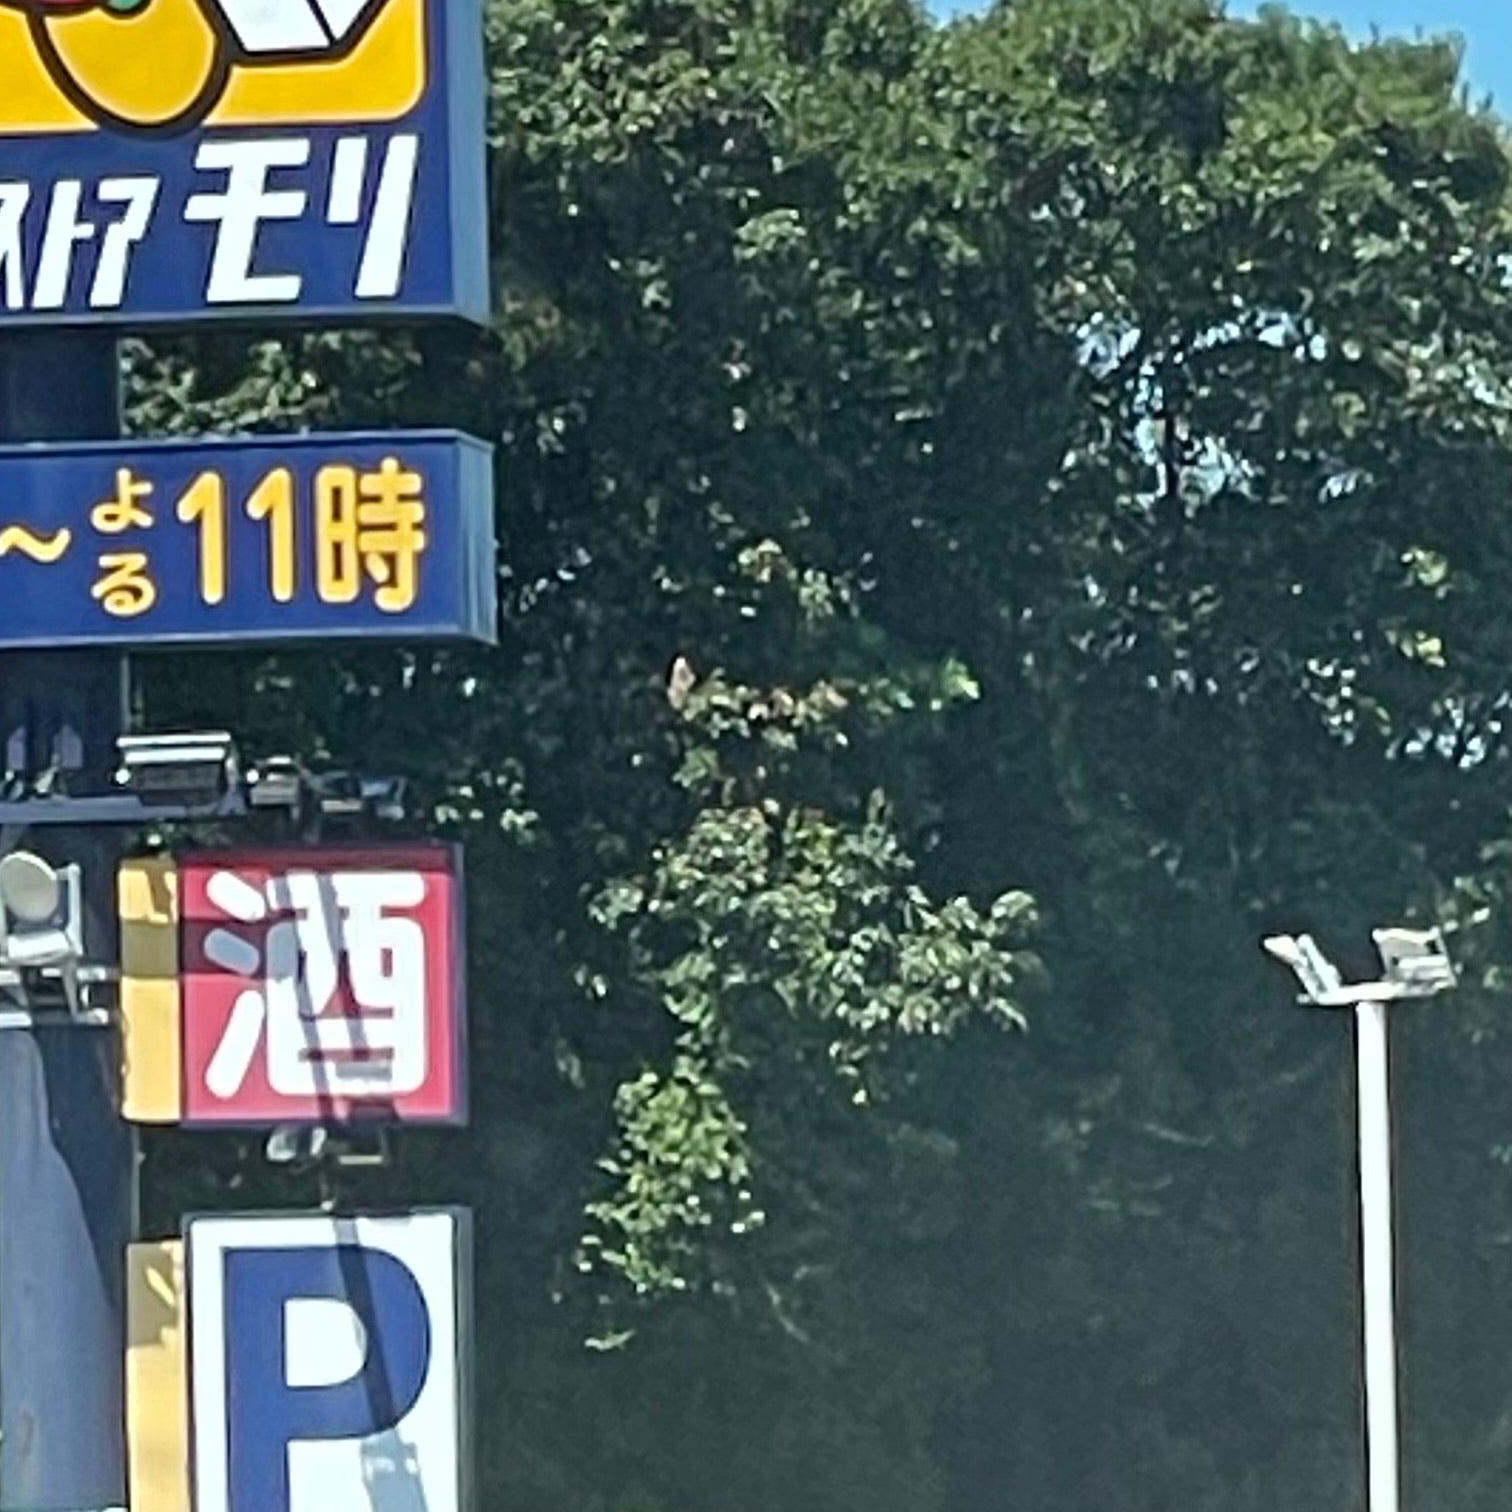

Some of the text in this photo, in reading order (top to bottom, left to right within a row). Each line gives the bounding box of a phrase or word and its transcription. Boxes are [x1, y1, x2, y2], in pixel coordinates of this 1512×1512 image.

[90, 467, 159, 619] よる
[176, 457, 428, 614] 11時
[201, 868, 429, 1100] 酒
[223, 1244, 432, 1512] P
